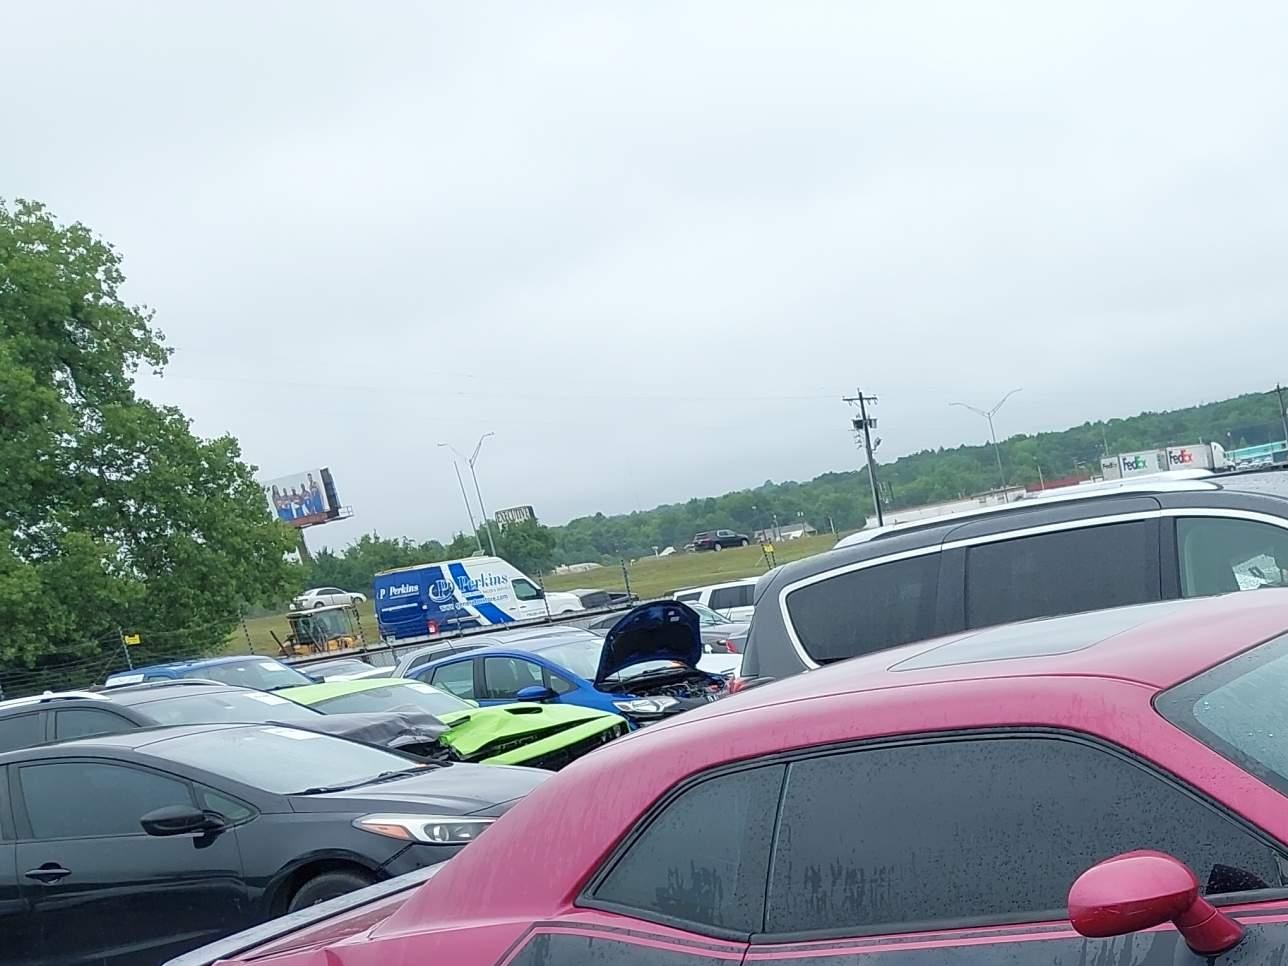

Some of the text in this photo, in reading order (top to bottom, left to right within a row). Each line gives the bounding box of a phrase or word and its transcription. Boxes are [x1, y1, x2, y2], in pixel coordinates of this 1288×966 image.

[1122, 456, 1148, 471] FedEx
[1168, 450, 1193, 465] FedEx
[389, 583, 419, 596] Perkins
[458, 573, 509, 594] Perkins
